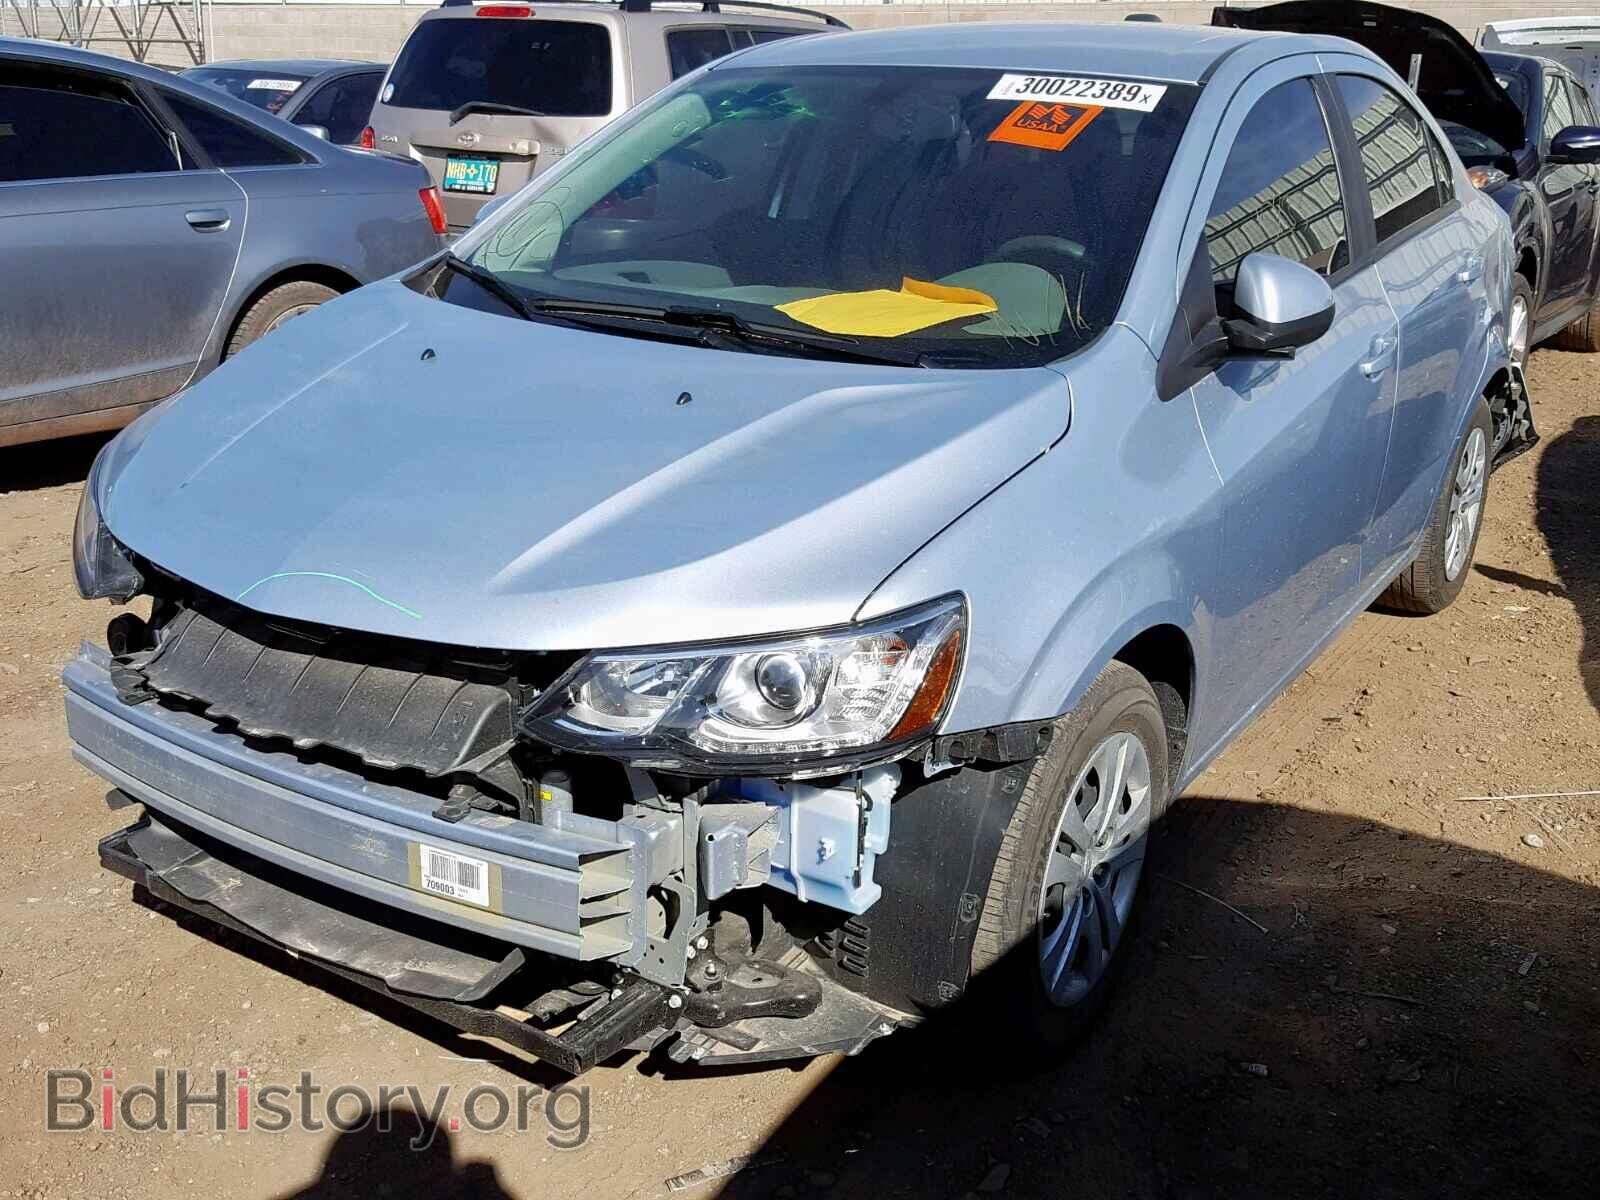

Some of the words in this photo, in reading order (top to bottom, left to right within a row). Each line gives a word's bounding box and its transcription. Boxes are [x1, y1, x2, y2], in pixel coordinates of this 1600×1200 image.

[1016, 77, 1142, 102] 30022389
[1017, 119, 1058, 132] USAA
[425, 878, 455, 895] 709003
